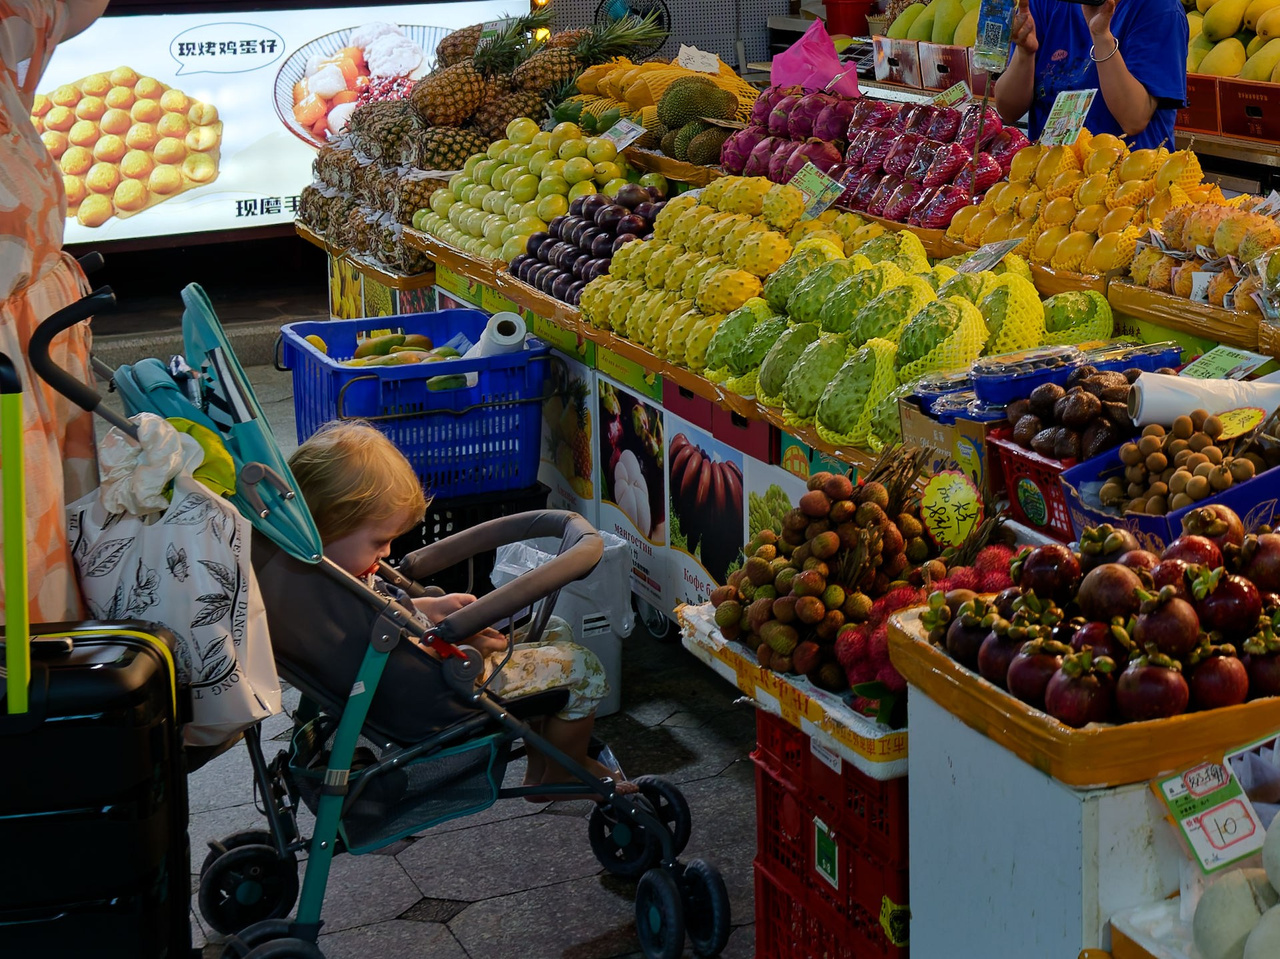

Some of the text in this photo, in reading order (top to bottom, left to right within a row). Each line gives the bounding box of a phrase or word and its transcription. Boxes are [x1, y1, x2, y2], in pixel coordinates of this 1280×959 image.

[177, 39, 278, 57] 现烤鸡蛋仔
[683, 568, 706, 593] Кофе
[1214, 817, 1237, 845] 10
